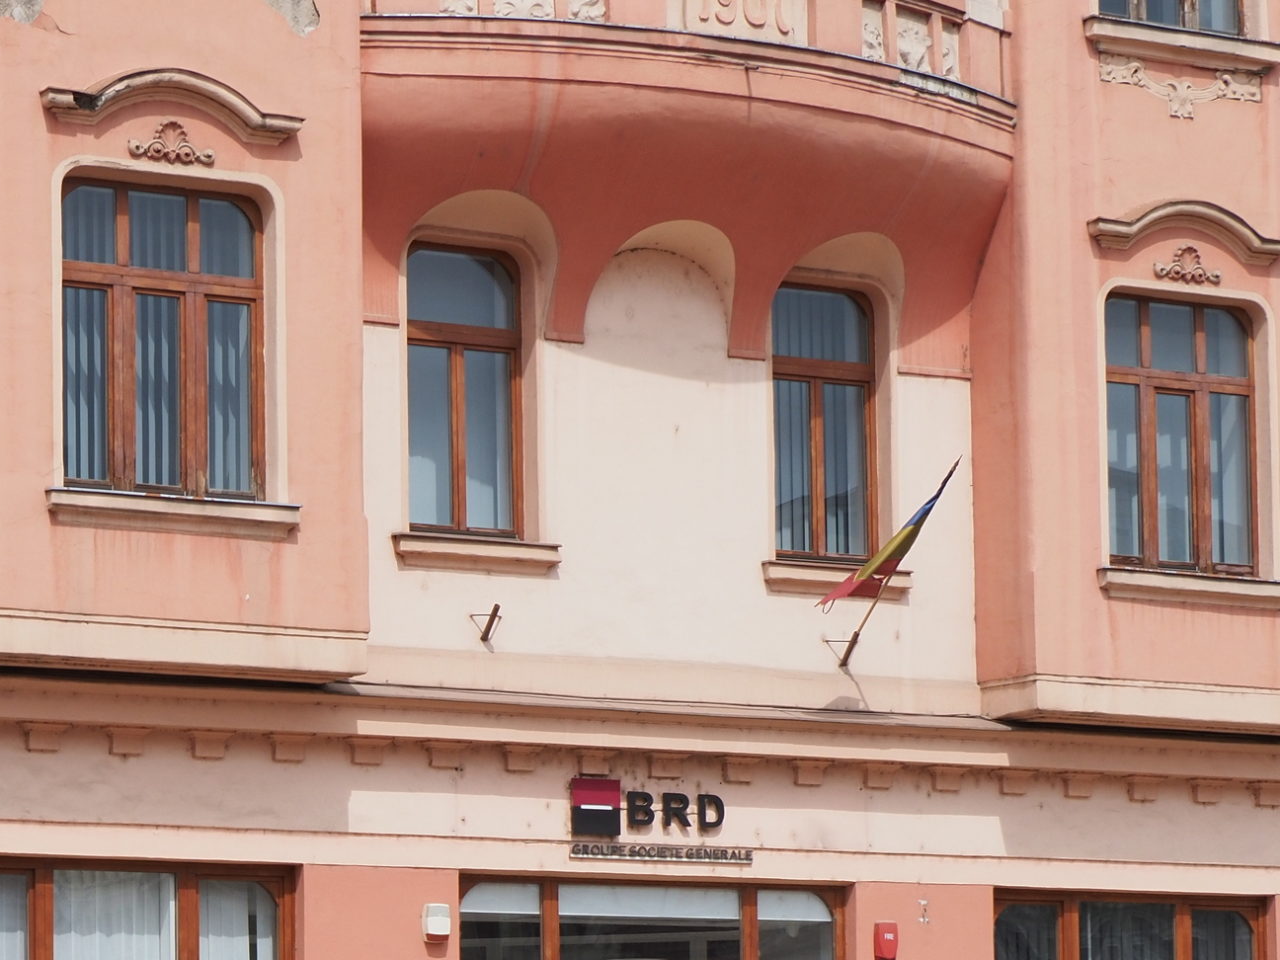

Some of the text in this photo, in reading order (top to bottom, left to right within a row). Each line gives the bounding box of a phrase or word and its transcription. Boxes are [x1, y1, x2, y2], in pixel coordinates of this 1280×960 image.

[626, 791, 725, 829] BRD
[572, 843, 753, 862] GROUPE SOCIETE GENERALE
